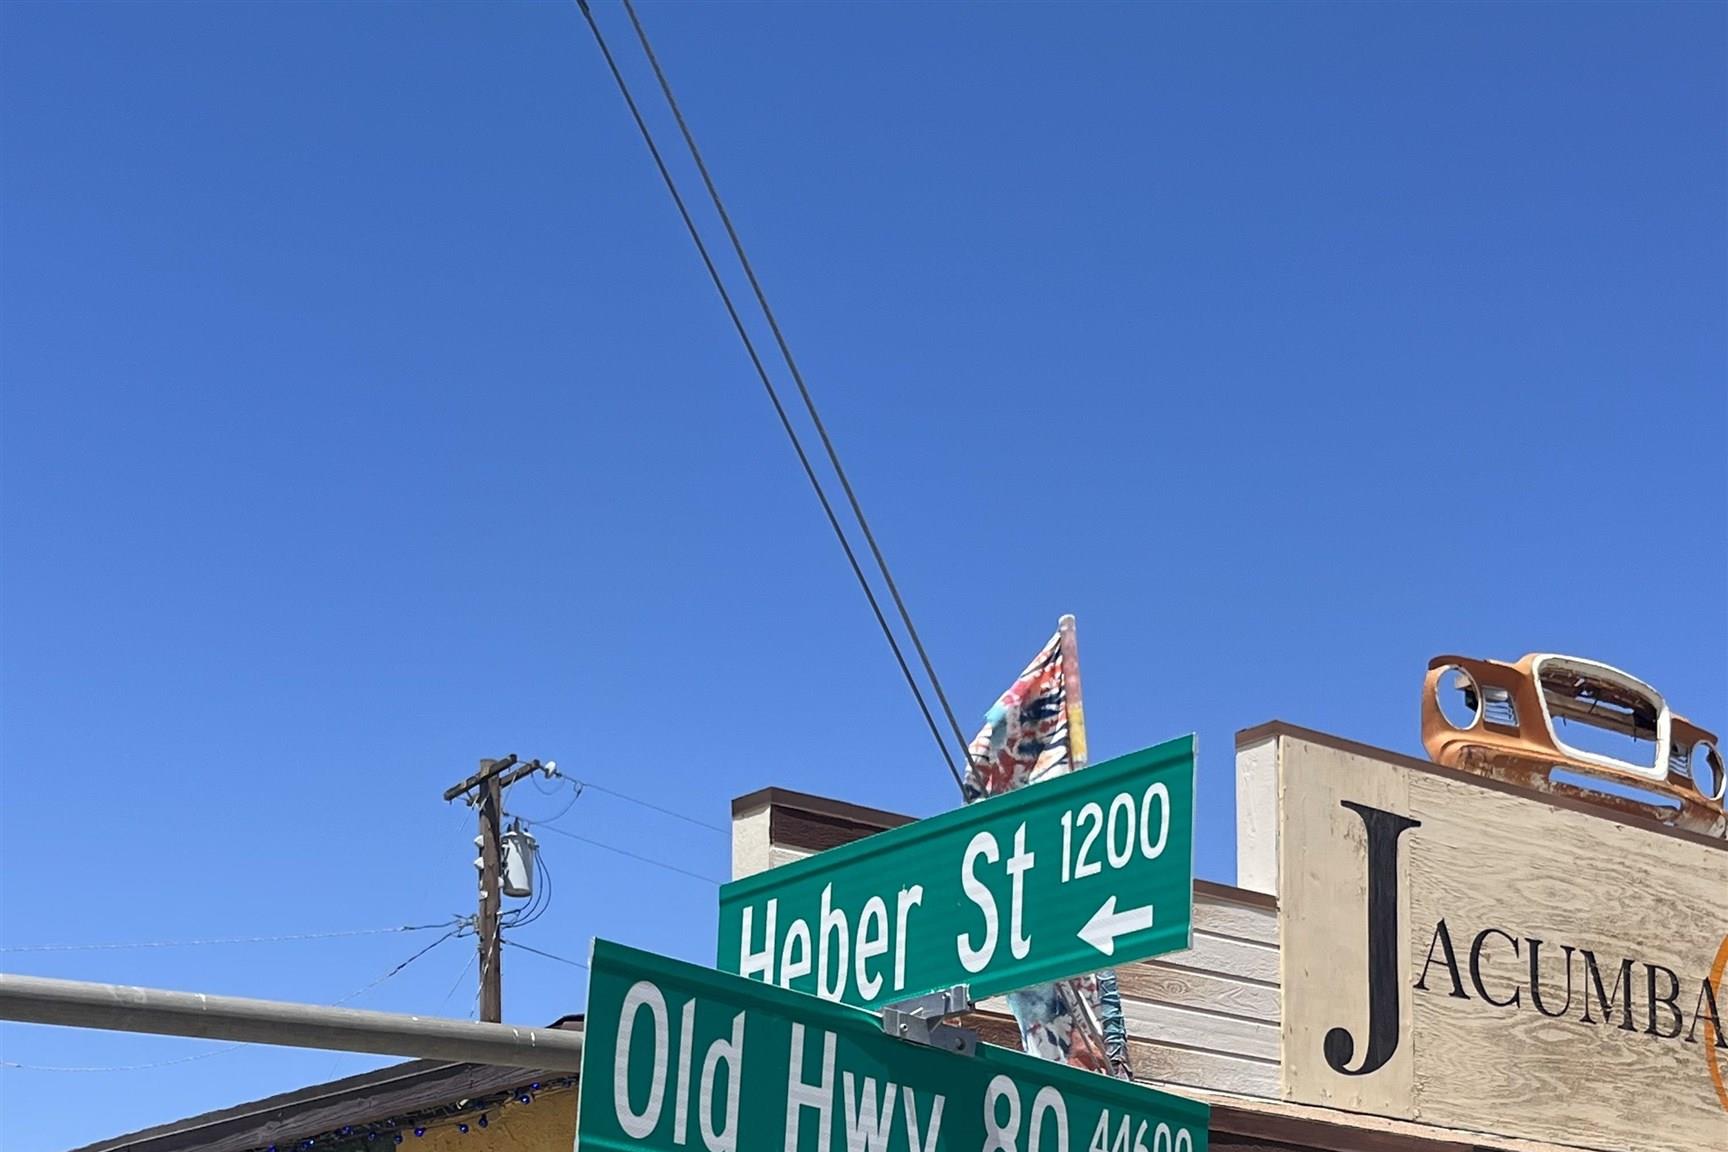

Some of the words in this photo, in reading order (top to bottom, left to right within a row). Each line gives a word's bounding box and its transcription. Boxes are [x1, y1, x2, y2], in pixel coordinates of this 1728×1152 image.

[739, 881, 924, 1003] Heber
[956, 821, 1035, 974] St
[1060, 782, 1170, 884] 1200
[1323, 799, 1728, 1076] JACUMBA
